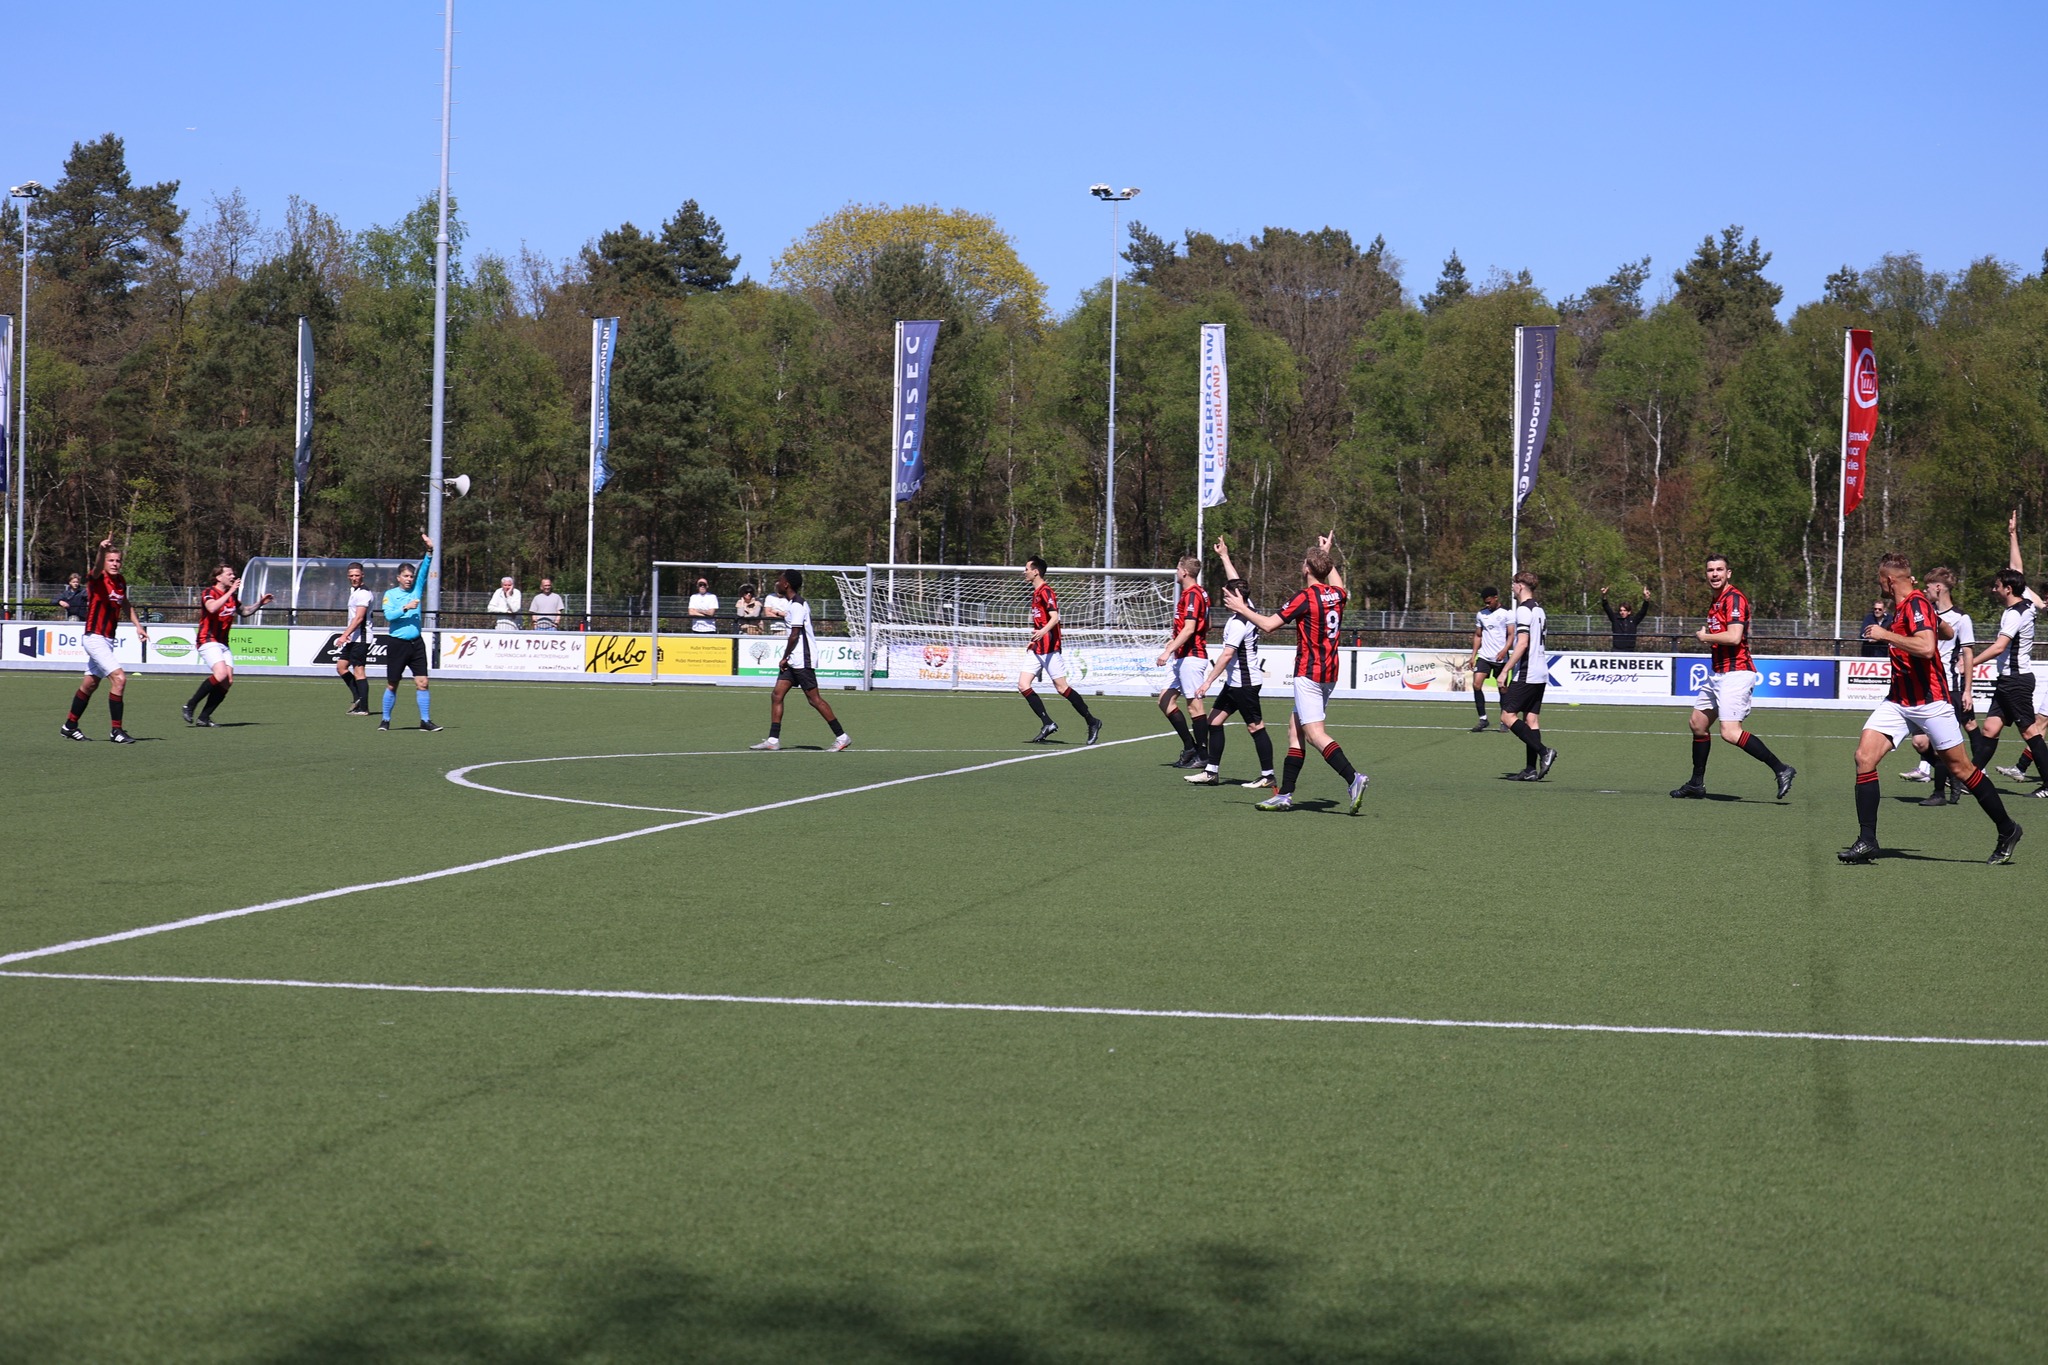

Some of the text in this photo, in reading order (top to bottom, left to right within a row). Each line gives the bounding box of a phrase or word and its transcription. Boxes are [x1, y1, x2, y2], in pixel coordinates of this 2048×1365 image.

[1326, 610, 1339, 638] 9
[59, 633, 77, 646] De
[499, 639, 520, 650] MIL
[527, 640, 566, 651] TOURS
[586, 635, 646, 672] Hubo
[1407, 662, 1436, 674] Hoeve
[1570, 658, 1664, 670] KLARENBEEK
[1364, 669, 1401, 682] Jacobus
[1571, 671, 1638, 684] Transport
